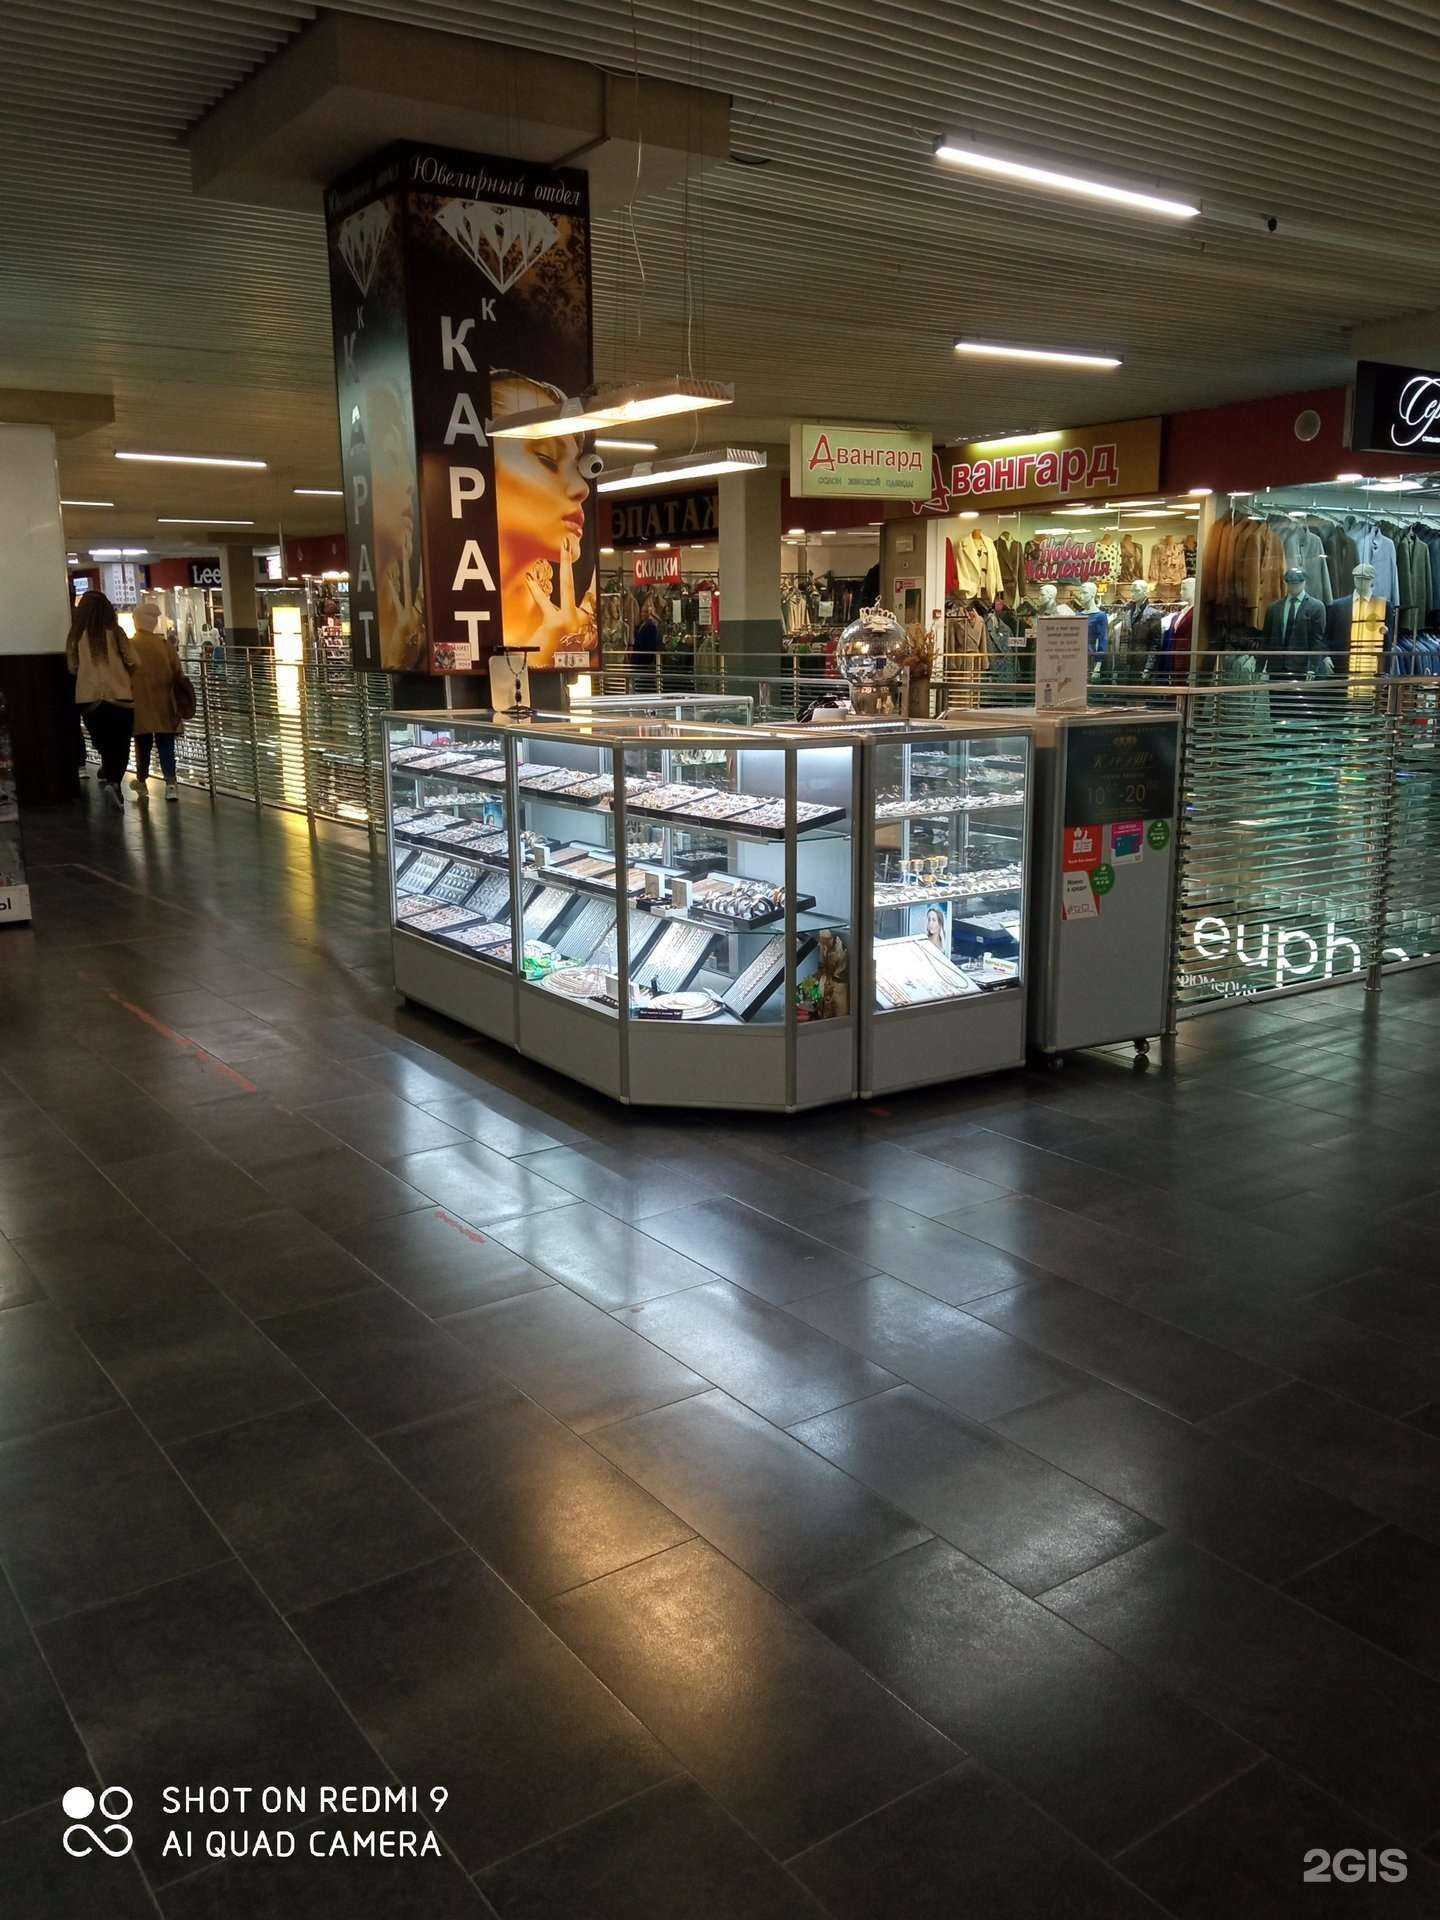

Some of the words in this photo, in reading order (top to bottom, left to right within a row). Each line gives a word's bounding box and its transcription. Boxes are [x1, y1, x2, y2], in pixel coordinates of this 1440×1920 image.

[410, 154, 526, 200] Ювелирный
[534, 179, 582, 206] отдел
[808, 432, 923, 472] Авангард
[440, 315, 497, 662] КАРАТ
[191, 565, 222, 584] Lee
[635, 557, 679, 580] СКИДКИ
